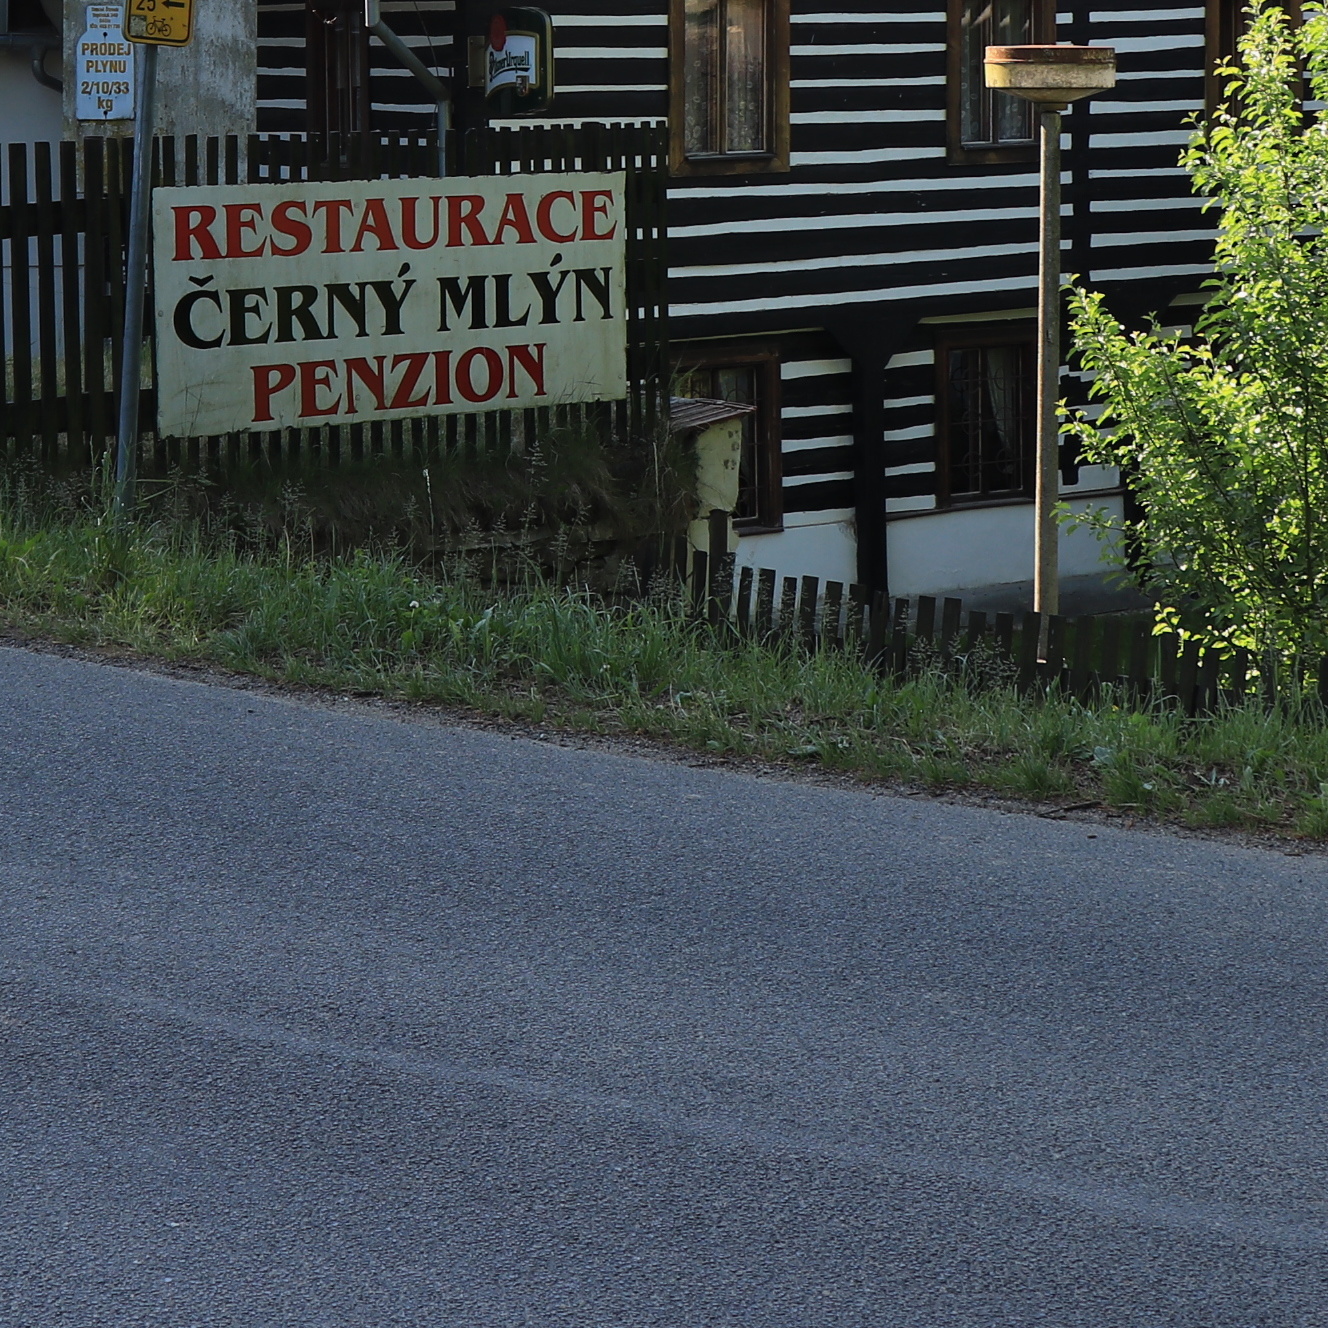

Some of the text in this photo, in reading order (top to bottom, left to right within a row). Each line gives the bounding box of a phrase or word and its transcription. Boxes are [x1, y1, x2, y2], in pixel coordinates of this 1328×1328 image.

[81, 42, 132, 56] PRODEJ
[85, 60, 127, 73] PLYNU
[81, 81, 130, 95] 2/10/33
[97, 97, 113, 112] kg
[171, 189, 618, 261] RESTAURACE
[173, 253, 613, 349] ČERNÝ MLÝN
[250, 342, 548, 422] PENZION
